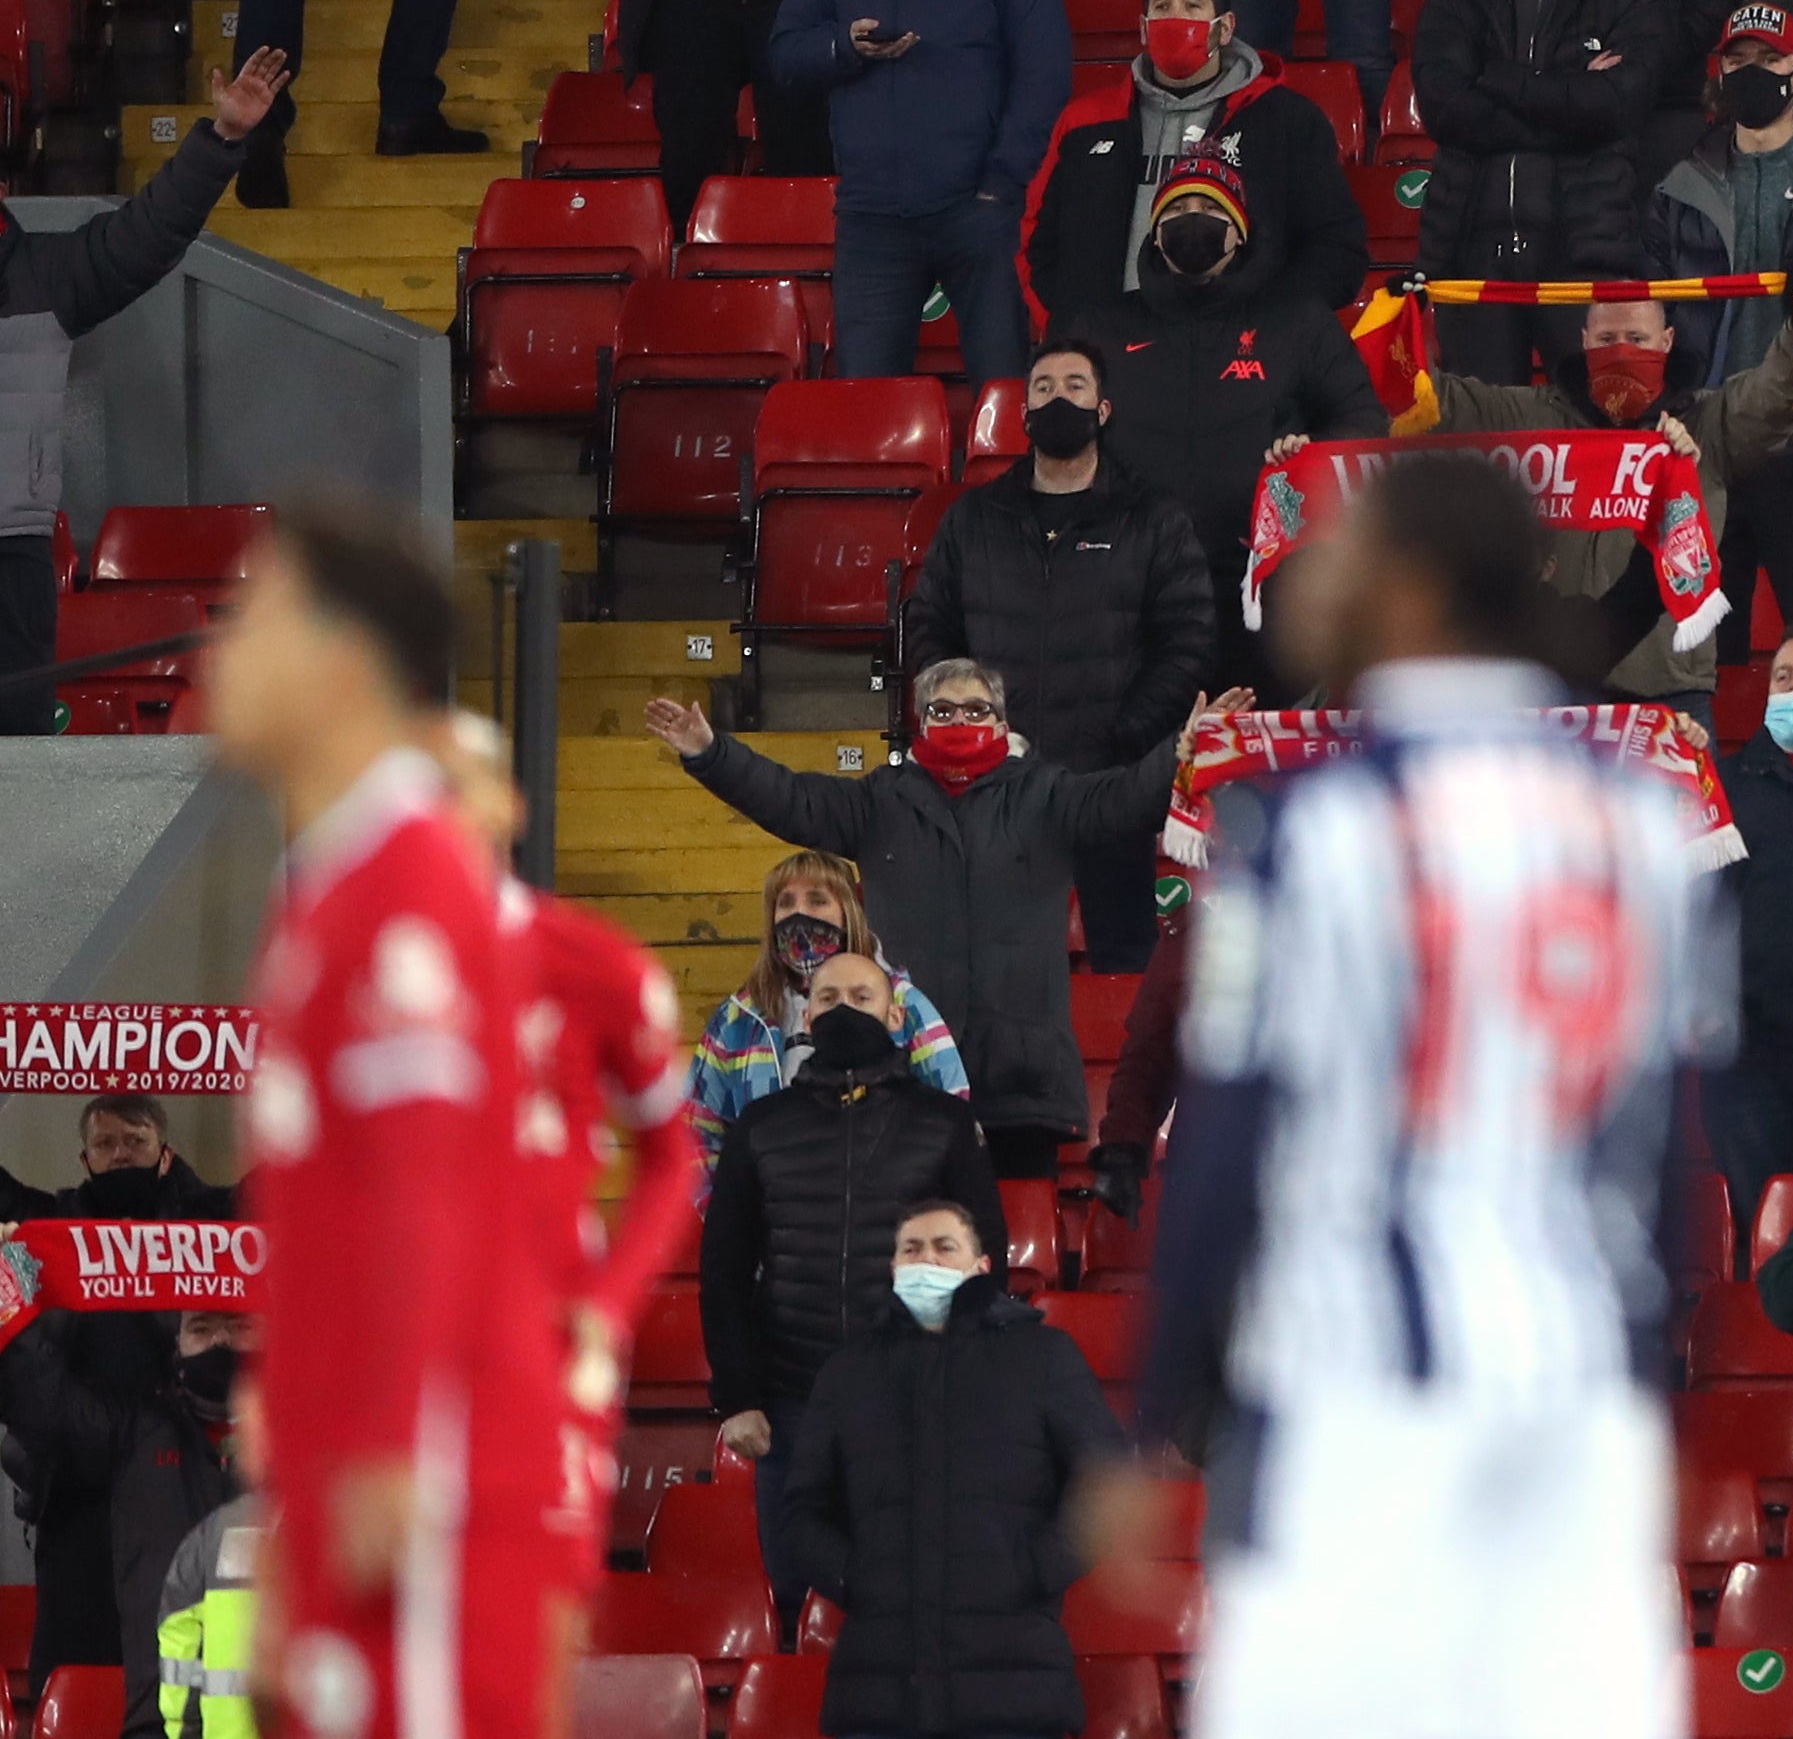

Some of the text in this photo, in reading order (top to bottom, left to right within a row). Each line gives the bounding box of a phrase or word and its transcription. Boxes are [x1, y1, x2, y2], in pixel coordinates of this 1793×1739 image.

[1732, 7, 1781, 24] CATEN
[157, 122, 171, 137] 22
[1220, 360, 1267, 380] AXA
[675, 434, 733, 459] 112
[1611, 442, 1673, 499] FC
[1589, 498, 1650, 523] ALONE
[814, 544, 872, 568] 113
[692, 638, 706, 653] 17
[844, 749, 857, 765] 16
[69, 1004, 165, 1020] LEAGUE
[126, 1071, 248, 1091] 2019/2020
[80, 1274, 247, 1299] YOU'LL NEVER
[621, 1465, 684, 1490] 115
